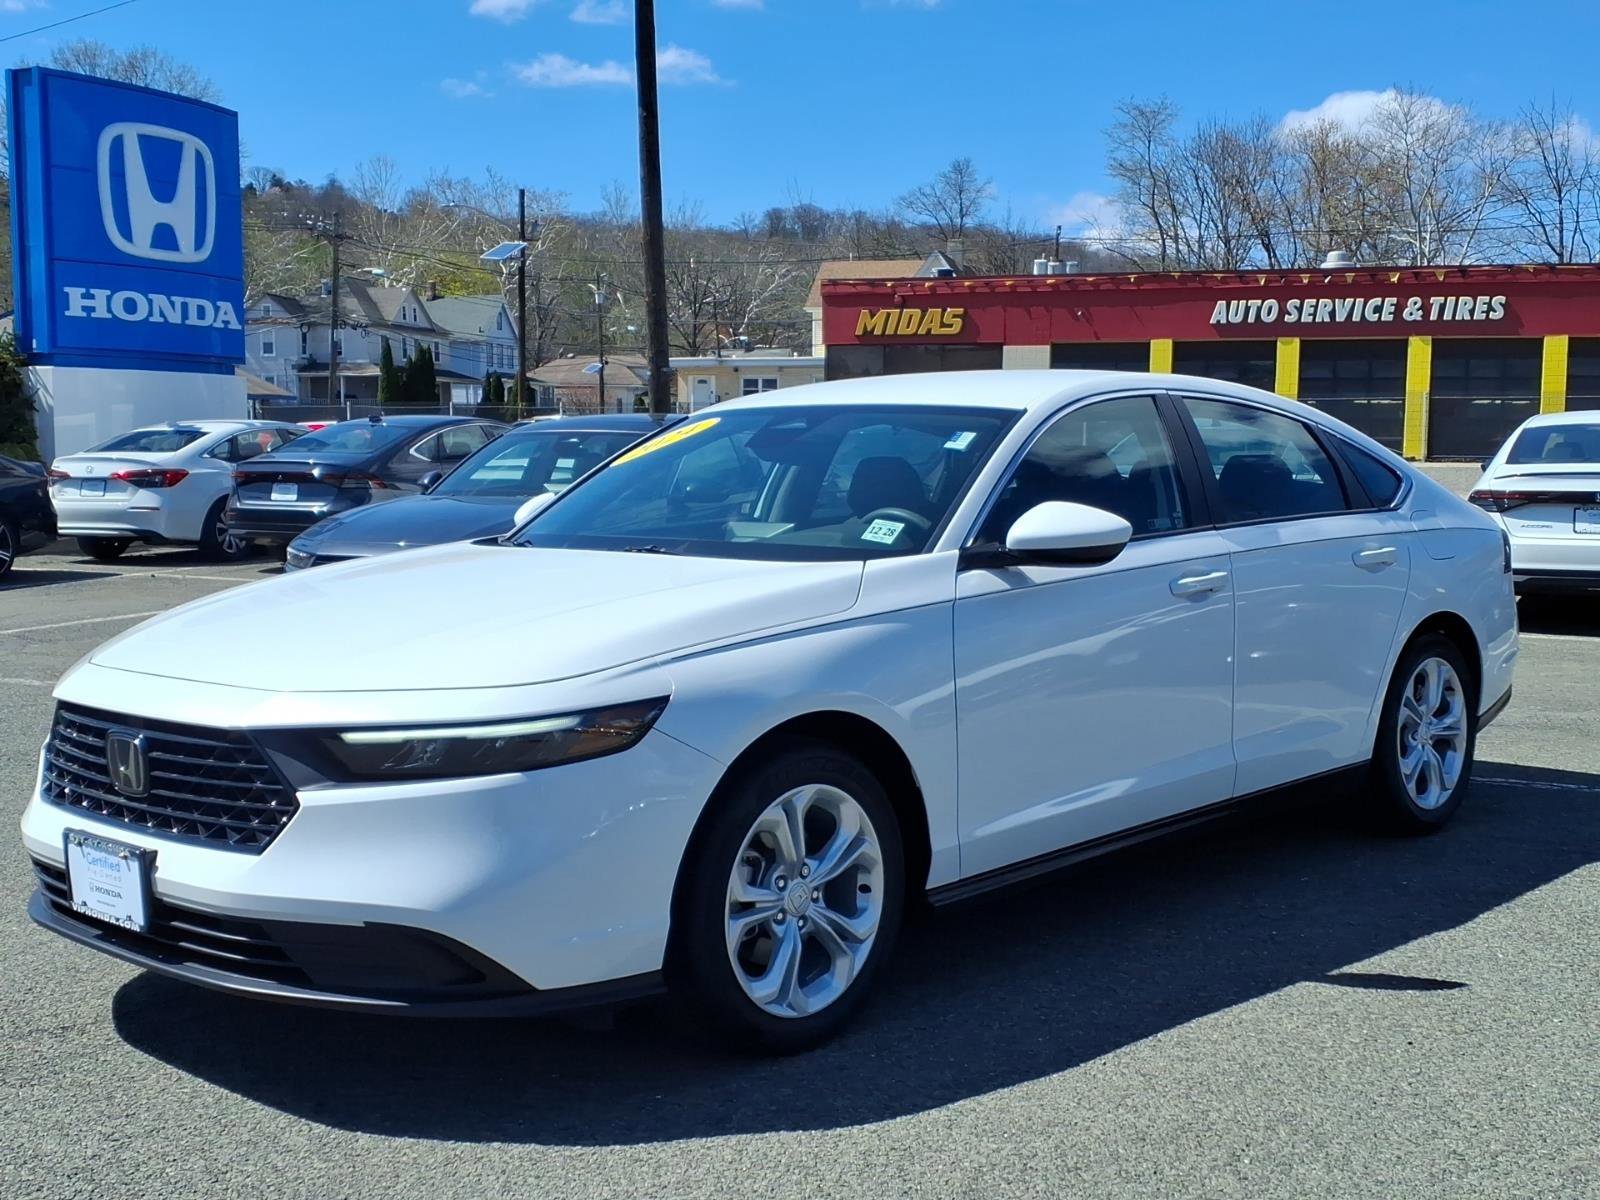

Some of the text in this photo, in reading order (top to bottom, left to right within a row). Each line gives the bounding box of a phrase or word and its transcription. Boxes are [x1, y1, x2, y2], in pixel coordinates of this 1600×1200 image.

[63, 286, 242, 330] HONDA
[1209, 295, 1507, 324] AUTO SERVICE & TIRES
[854, 307, 965, 336] MIDAS
[868, 526, 896, 537] 12 28
[86, 852, 121, 873] Certified
[94, 885, 123, 899] HONDA
